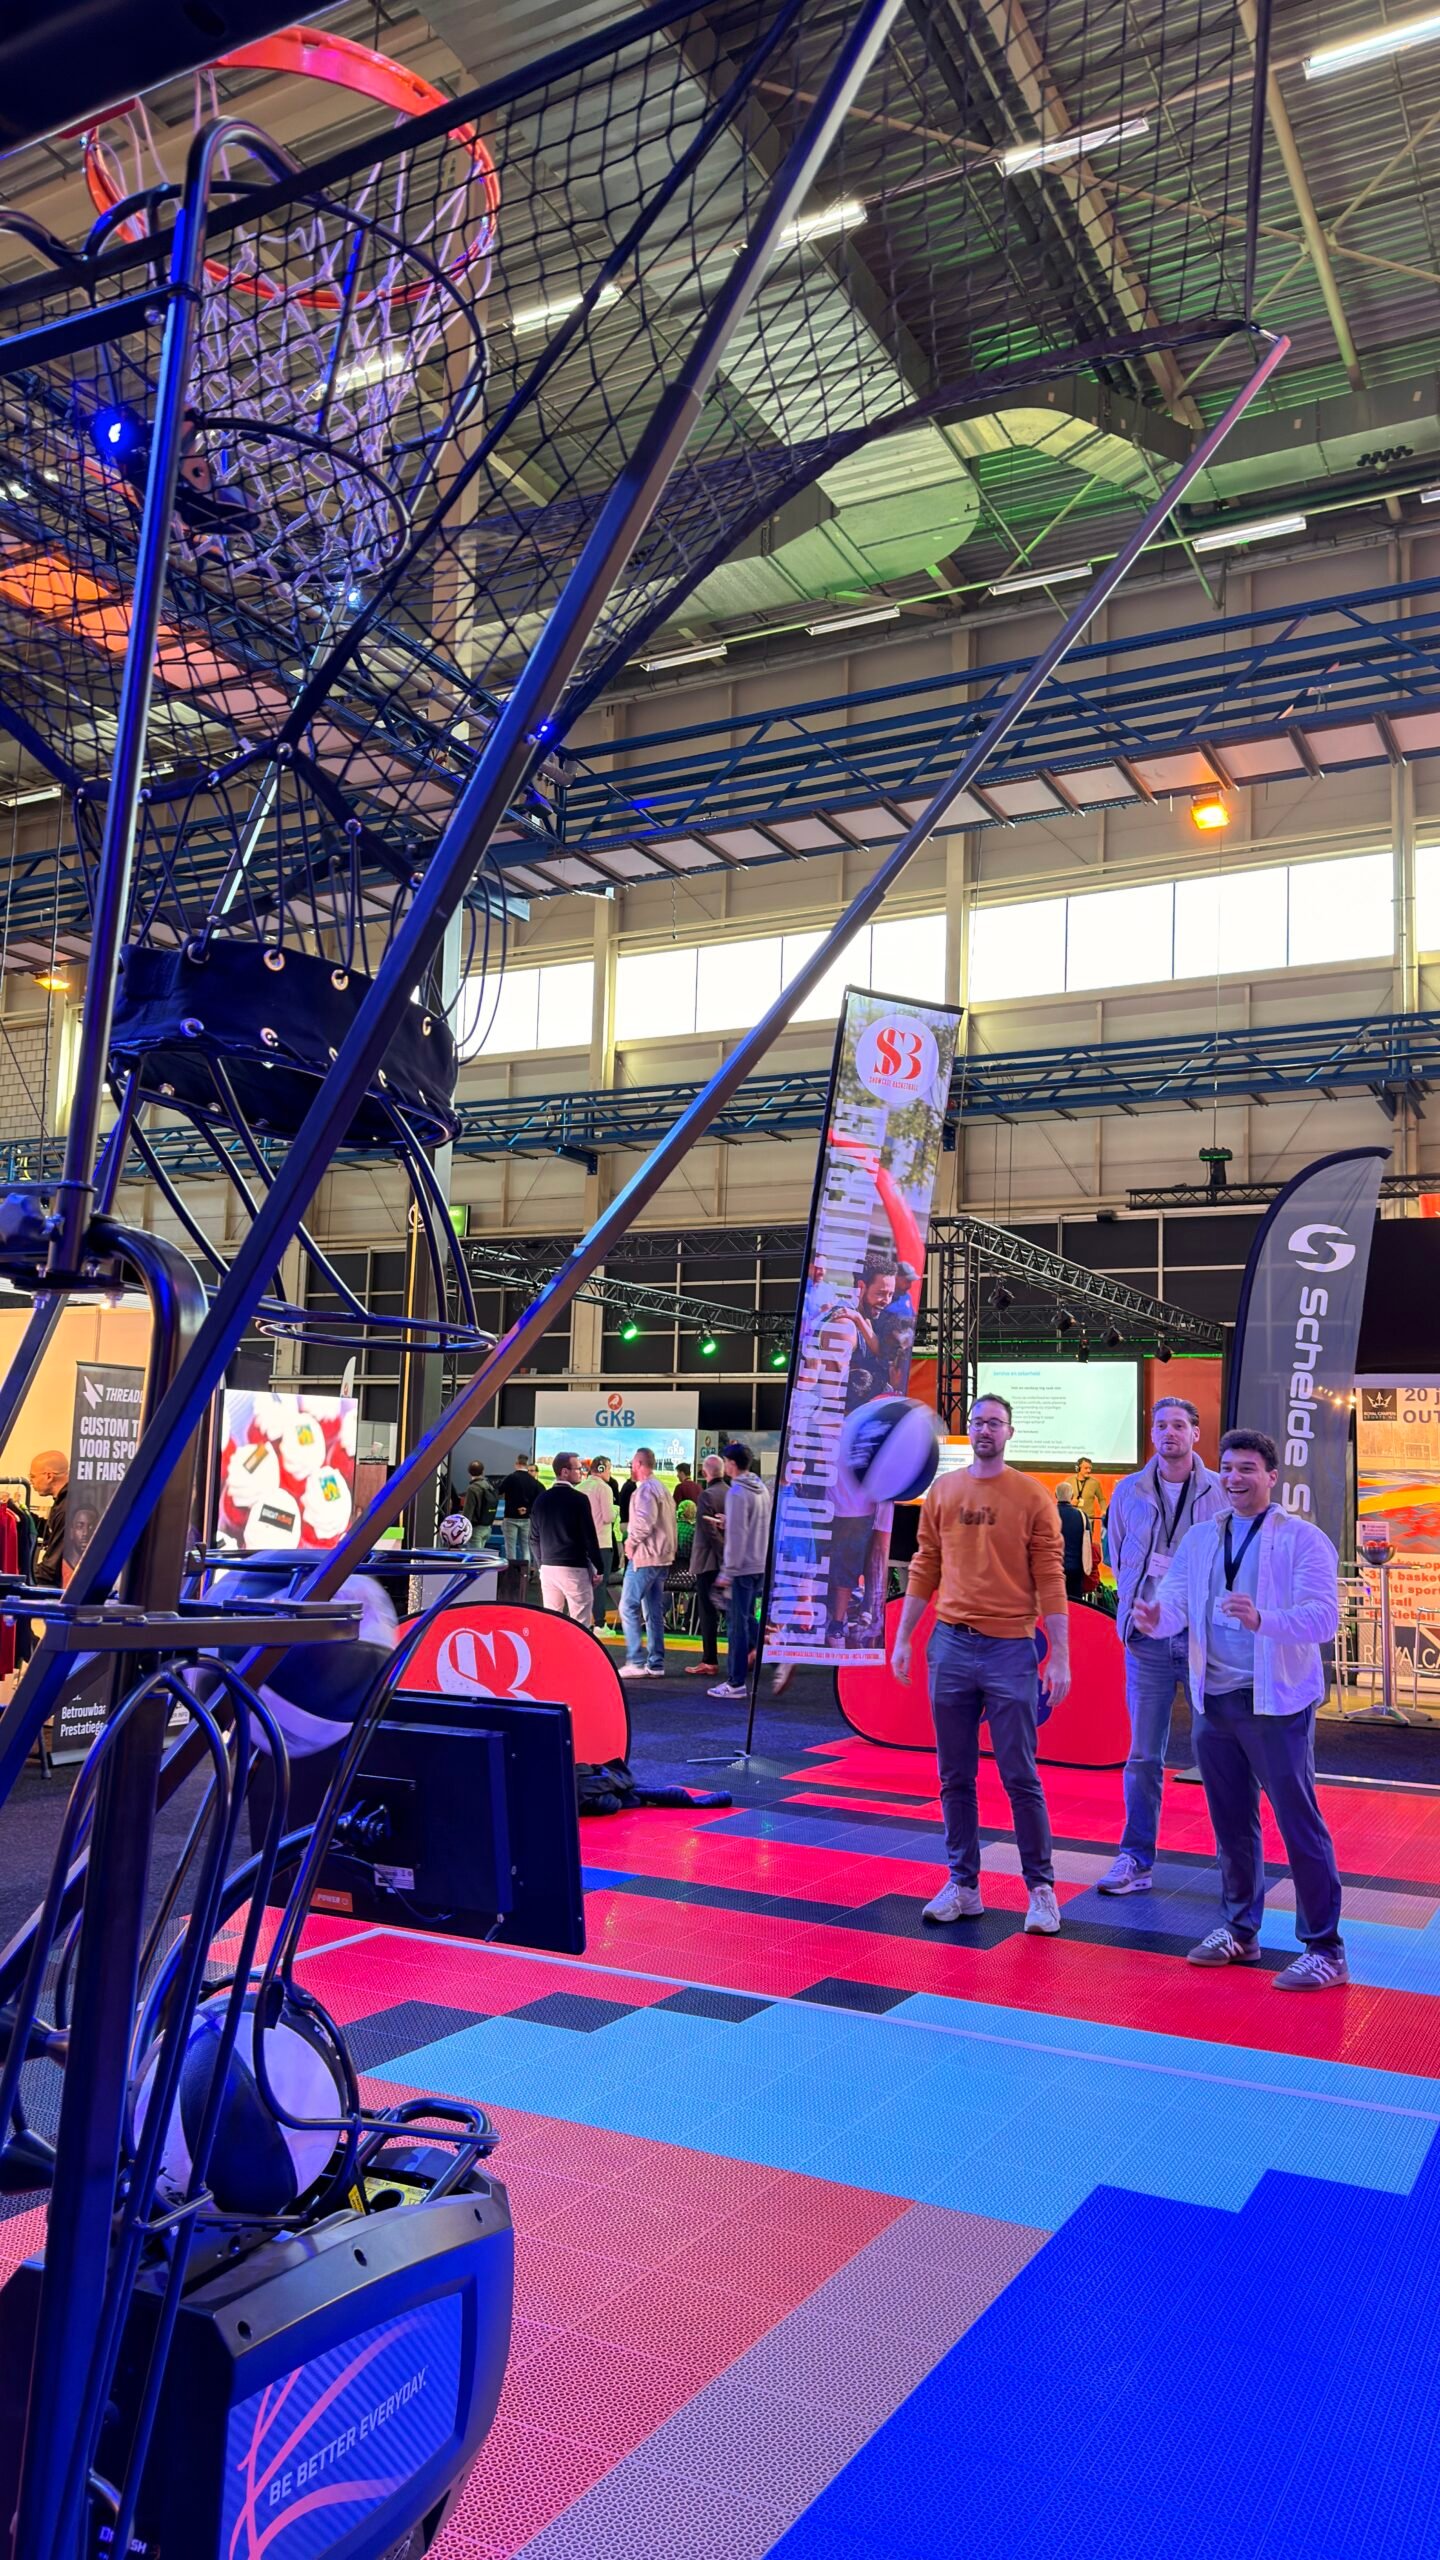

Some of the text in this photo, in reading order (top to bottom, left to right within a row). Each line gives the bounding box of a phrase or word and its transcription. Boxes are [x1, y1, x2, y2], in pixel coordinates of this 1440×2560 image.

[813, 1098, 889, 1274] INTERACT
[784, 1317, 858, 1488] CONNECT
[1404, 1388, 1428, 1402] 20
[80, 1416, 129, 1438] CUSTOM
[595, 1408, 635, 1427] GKB
[79, 1439, 111, 1458] VOOR
[77, 1461, 126, 1481] EN FANS
[775, 1497, 836, 1550] TO
[768, 1552, 831, 1646] LOVE
[269, 2367, 427, 2506] BE BETTER EVERYDAY.
